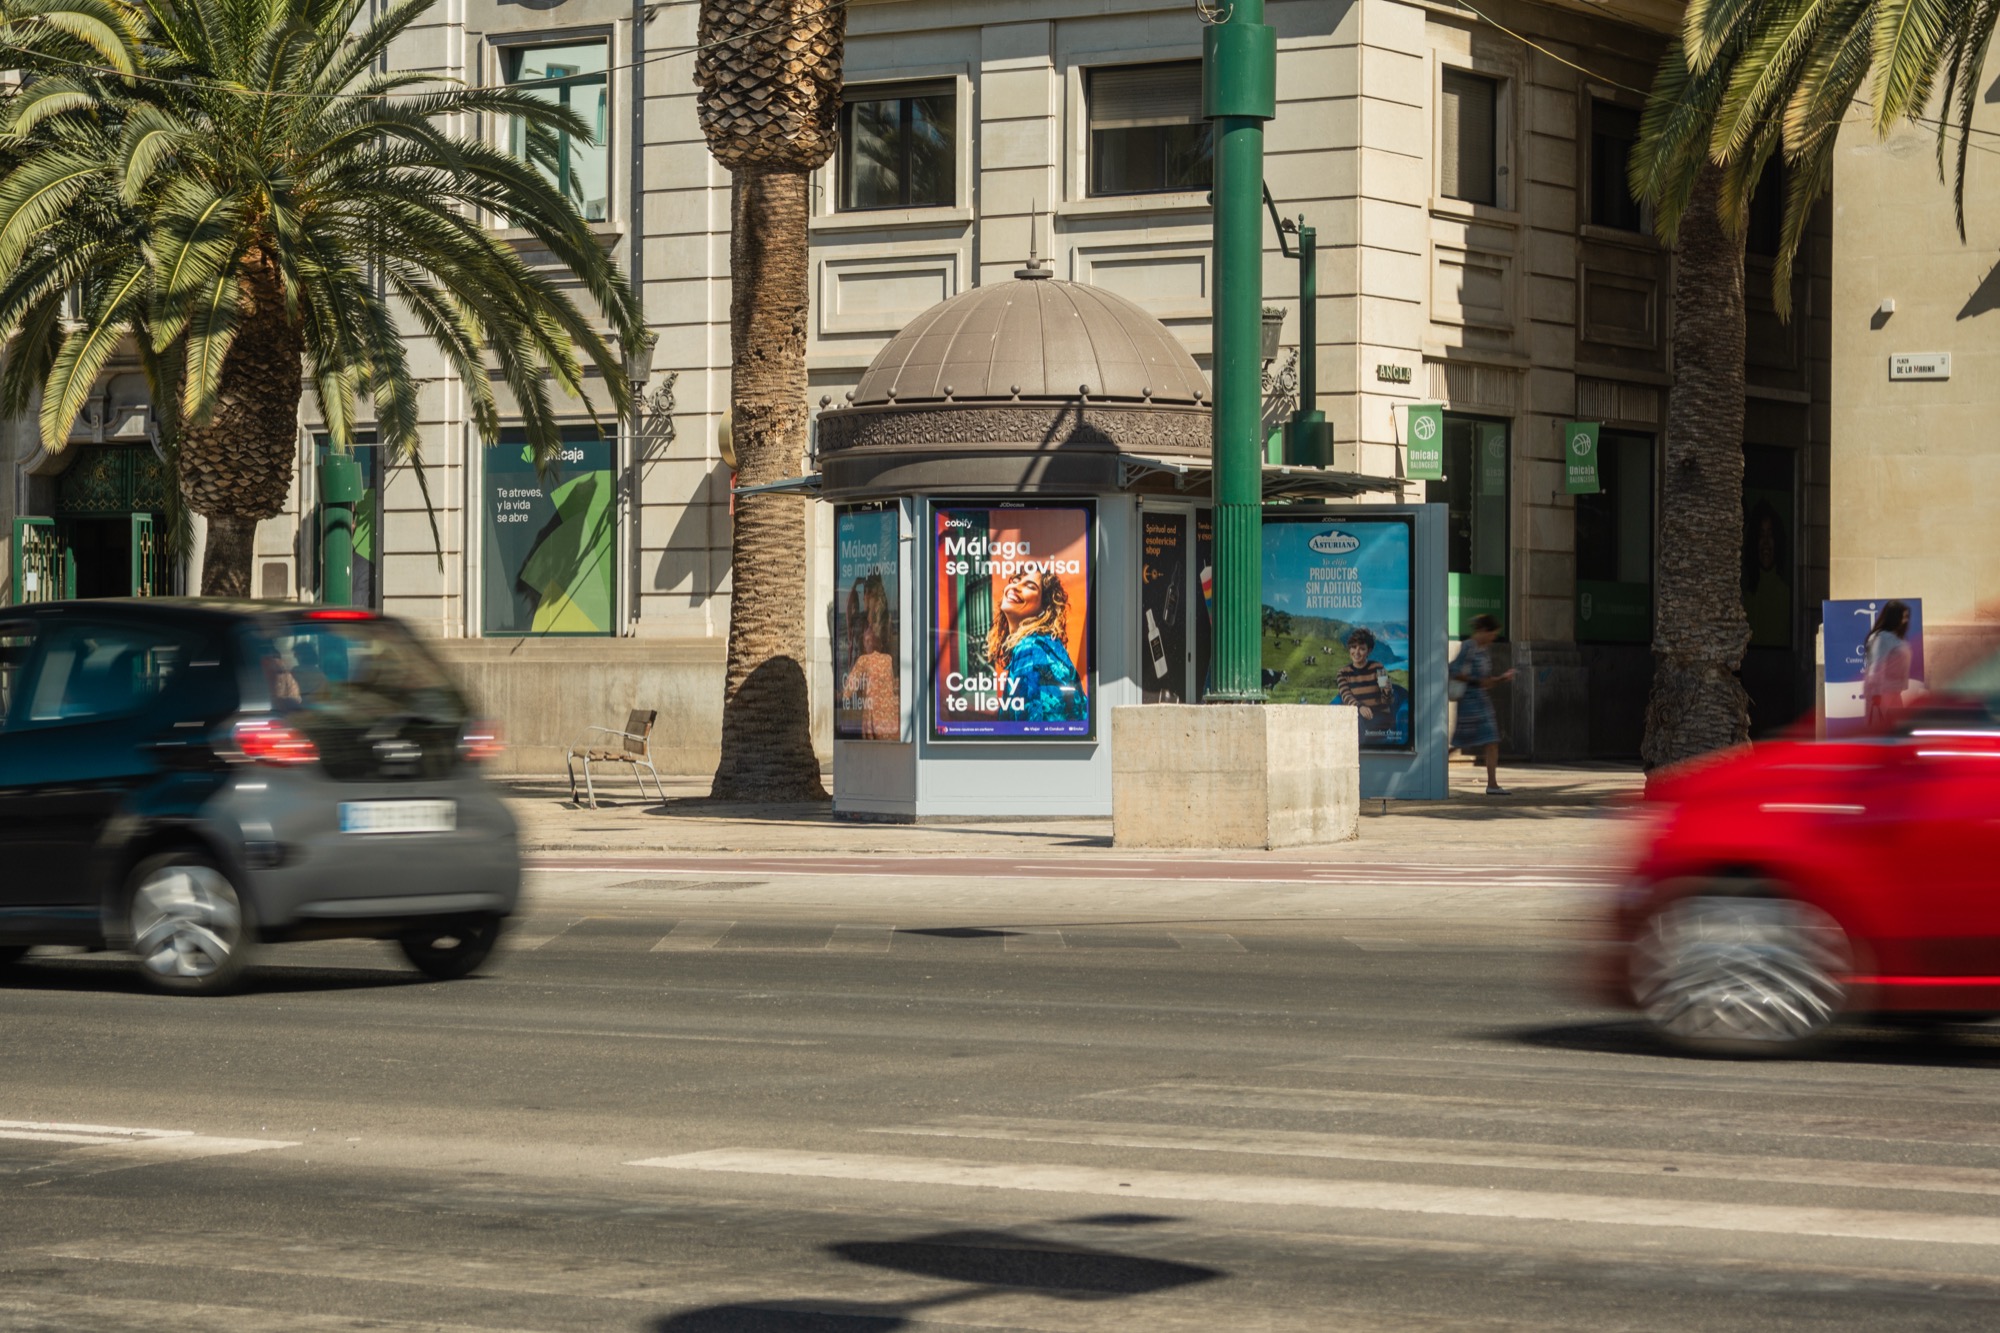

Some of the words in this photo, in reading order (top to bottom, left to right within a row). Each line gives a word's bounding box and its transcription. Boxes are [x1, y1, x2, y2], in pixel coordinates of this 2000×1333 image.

[1380, 365, 1411, 380] ANCLA
[1897, 366, 1903, 374] DE
[1913, 365, 1935, 373] MARINA
[1410, 449, 1438, 460] Unicaja
[1569, 465, 1594, 476] Unicaja
[497, 488, 507, 497] Te
[509, 488, 543, 497] atreves,
[497, 503, 502, 513] y
[504, 501, 511, 509] la
[513, 500, 530, 509] vida
[509, 513, 528, 522] abre
[944, 518, 973, 529] cabify
[1146, 523, 1166, 534] Spiritual
[1167, 525, 1176, 533] and
[944, 536, 1030, 559] Málaga
[1312, 539, 1356, 548] ASTURIANA
[842, 540, 877, 561] Málaga
[1146, 546, 1160, 557] shop
[842, 563, 852, 577] se
[854, 556, 896, 580] improvisa
[945, 560, 969, 575] se
[975, 555, 1080, 579] improvisa
[1309, 567, 1358, 580] PRODUCTOS
[1306, 582, 1320, 594] SIN
[1323, 582, 1362, 594] ADITIVOS
[1306, 596, 1362, 608] ARTIFICIALES
[946, 672, 1021, 695] Cabify
[946, 694, 968, 712] te
[974, 692, 1025, 712] lleva
